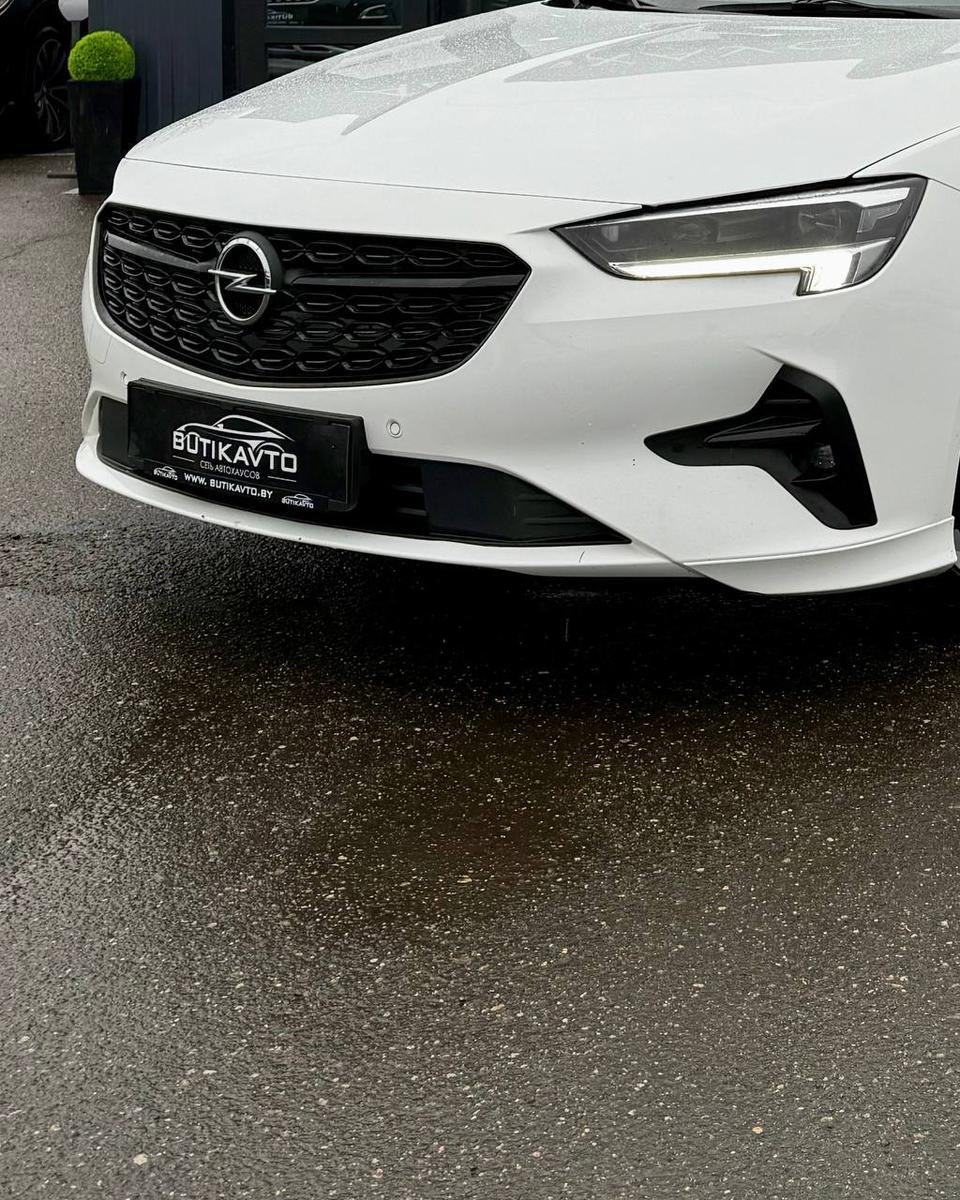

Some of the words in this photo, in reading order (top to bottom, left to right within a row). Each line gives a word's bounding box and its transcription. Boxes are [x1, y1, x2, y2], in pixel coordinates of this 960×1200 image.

[172, 430, 297, 473] BUTIKAVTO
[199, 459, 214, 471] СЕТЬ
[215, 464, 260, 480] АВТОХАУСОВ
[183, 472, 207, 486] WWW.
[209, 478, 274, 499] BUTIKAVTO.BY
